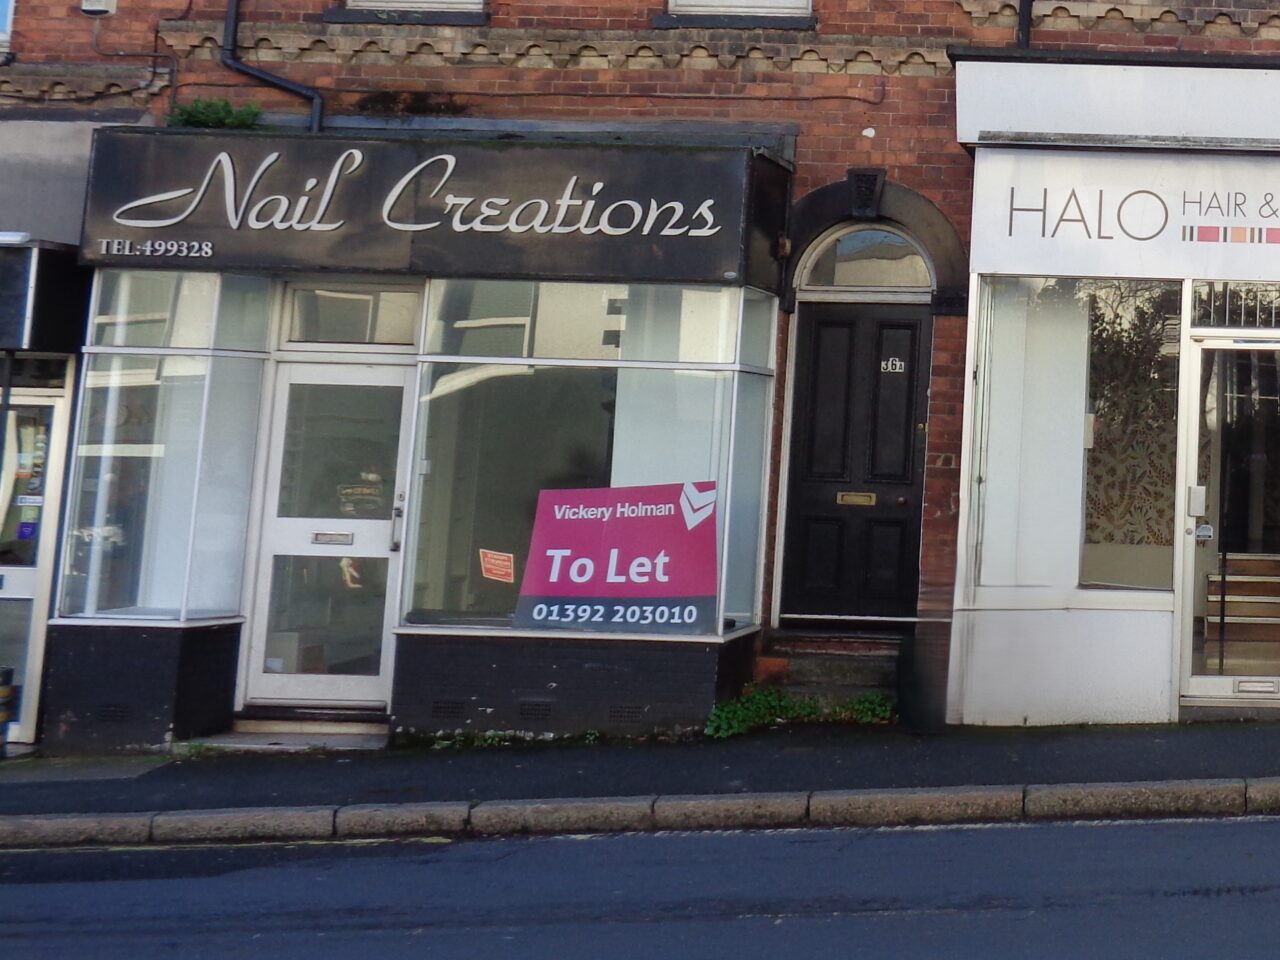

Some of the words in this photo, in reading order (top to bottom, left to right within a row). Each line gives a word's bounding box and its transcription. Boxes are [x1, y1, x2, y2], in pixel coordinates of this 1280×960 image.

[112, 148, 363, 231] Nail
[382, 153, 723, 237] Creations
[1008, 186, 1169, 241] HALO
[1183, 191, 1247, 218] HAIR
[1258, 192, 1279, 218] &
[99, 239, 213, 257] TEL:499328
[553, 504, 612, 522] Vickery
[616, 502, 675, 518] Holman
[545, 548, 594, 583] To
[606, 548, 670, 583] Let
[532, 604, 604, 622] 01392
[611, 605, 697, 624] 203010
